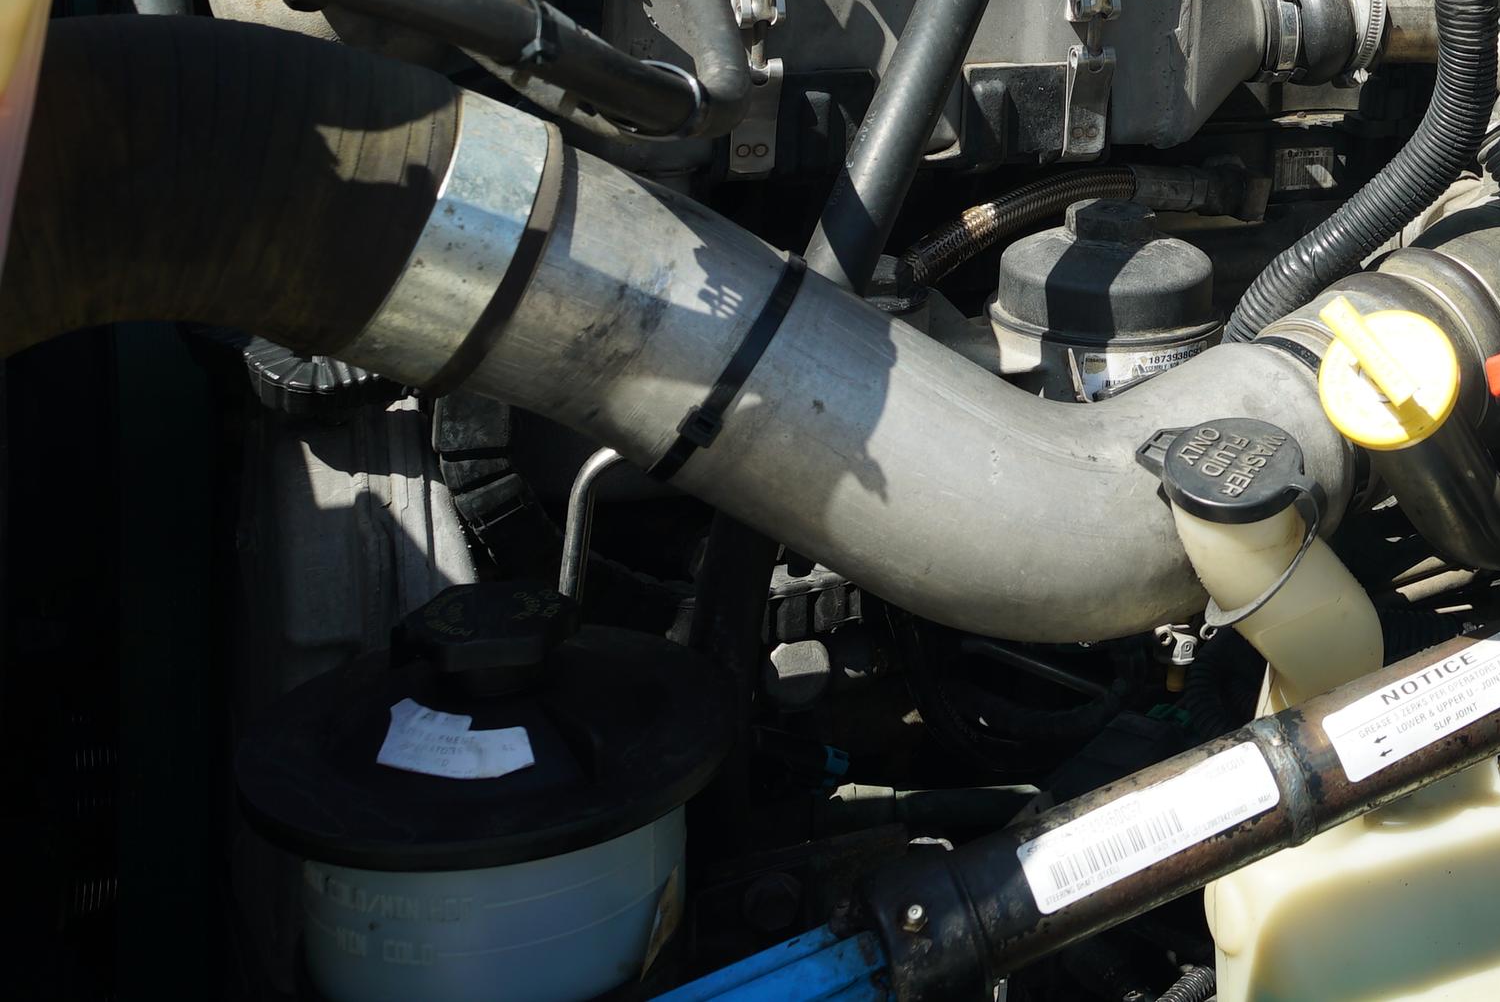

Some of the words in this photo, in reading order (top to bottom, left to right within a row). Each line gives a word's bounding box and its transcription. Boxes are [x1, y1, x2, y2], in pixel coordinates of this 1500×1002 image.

[1178, 427, 1221, 466] ONLY
[1201, 434, 1251, 477] FLUID
[1220, 434, 1287, 498] WASHER
[1381, 651, 1478, 706] NOTICE
[1358, 716, 1392, 739] GREASE
[1430, 689, 1448, 706] PER
[1447, 662, 1497, 698] OPERATORS
[1396, 713, 1427, 734] LOWER
[1437, 694, 1466, 713] UPPER
[1433, 715, 1452, 731] SLIP
[1455, 701, 1478, 720] JOINT
[383, 938, 434, 967] COLD
